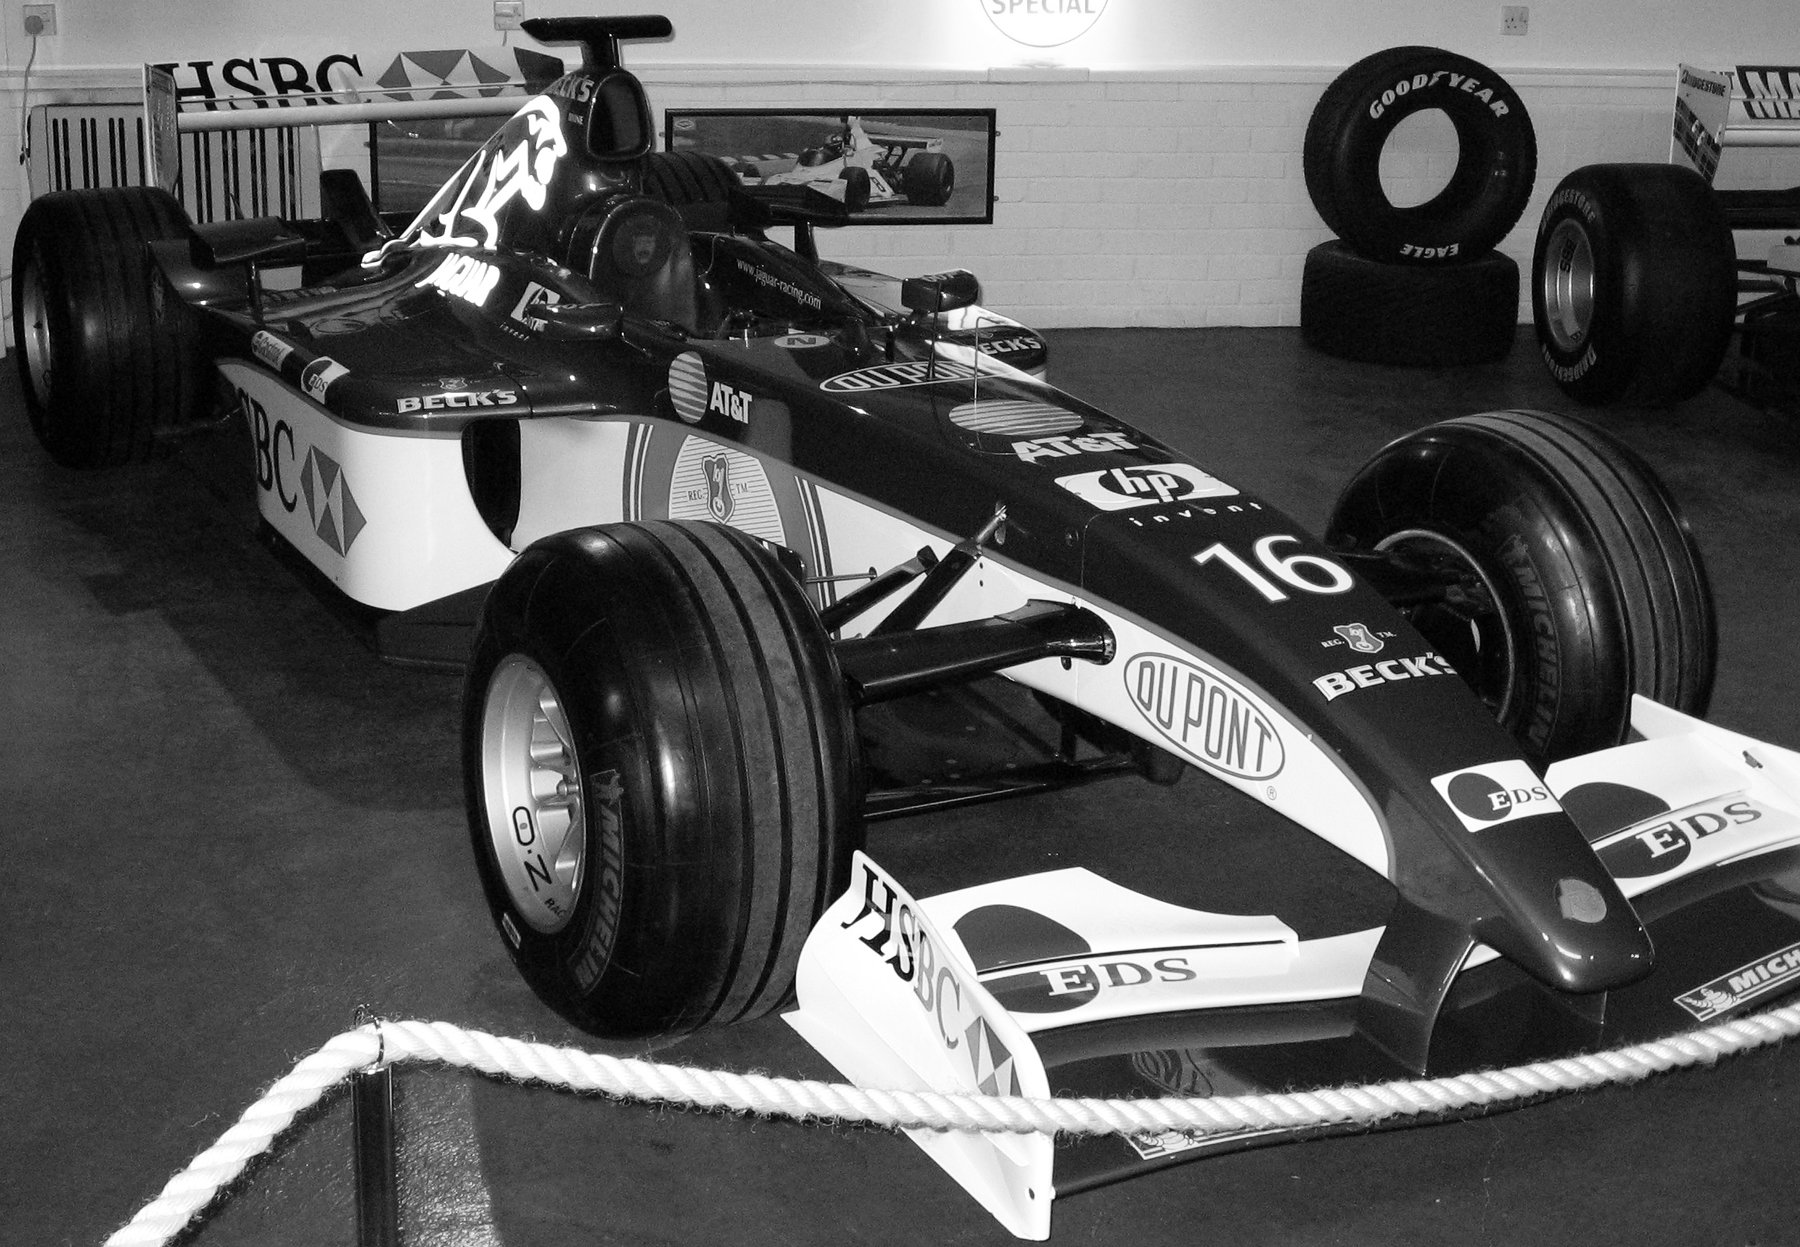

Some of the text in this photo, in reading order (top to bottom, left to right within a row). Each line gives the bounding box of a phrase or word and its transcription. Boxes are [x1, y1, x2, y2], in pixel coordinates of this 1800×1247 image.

[1369, 71, 1510, 119] GOODYEAR
[1400, 243, 1460, 259] EAGLE
[396, 389, 517, 414] BECK'S
[709, 381, 753, 424] AT&T
[1011, 432, 1139, 465] AT&T
[1110, 468, 1179, 502] hp
[1128, 502, 1262, 527] invent
[1193, 535, 1354, 602] 16
[1312, 651, 1457, 702] BECK'S
[1182, 672, 1272, 773] PONT
[1487, 786, 1549, 811] EDS
[1634, 801, 1762, 858] EDS
[840, 863, 961, 1050] HSBC
[1039, 958, 1198, 996] EDS
